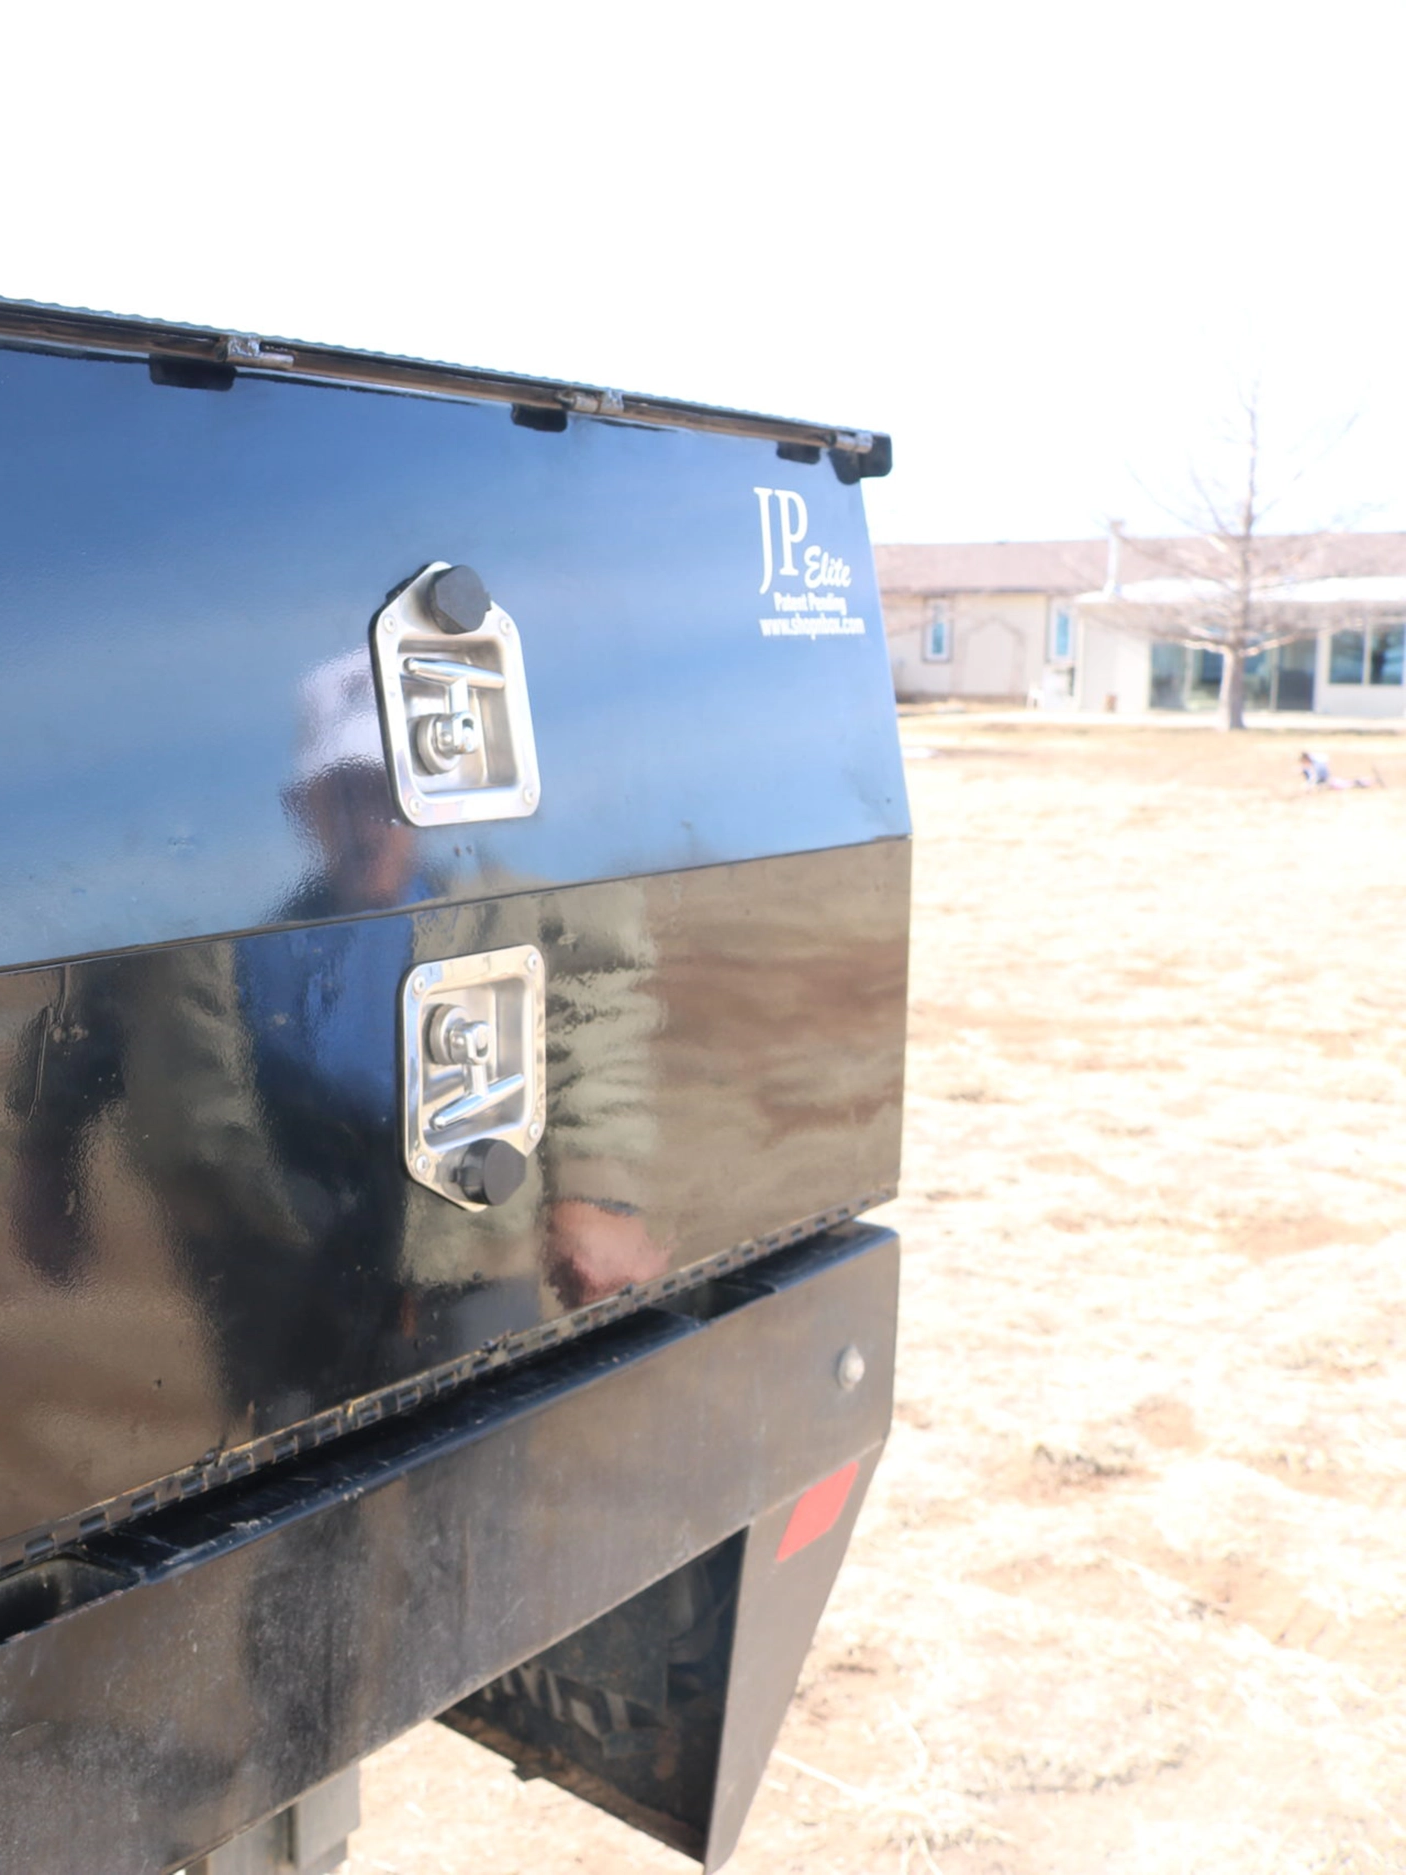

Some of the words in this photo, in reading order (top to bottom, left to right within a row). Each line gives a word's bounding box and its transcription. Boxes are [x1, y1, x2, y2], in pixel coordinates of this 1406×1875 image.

[753, 487, 808, 594] JP
[804, 545, 852, 589] Elite
[773, 592, 807, 611] Patent
[807, 592, 847, 615] Pending
